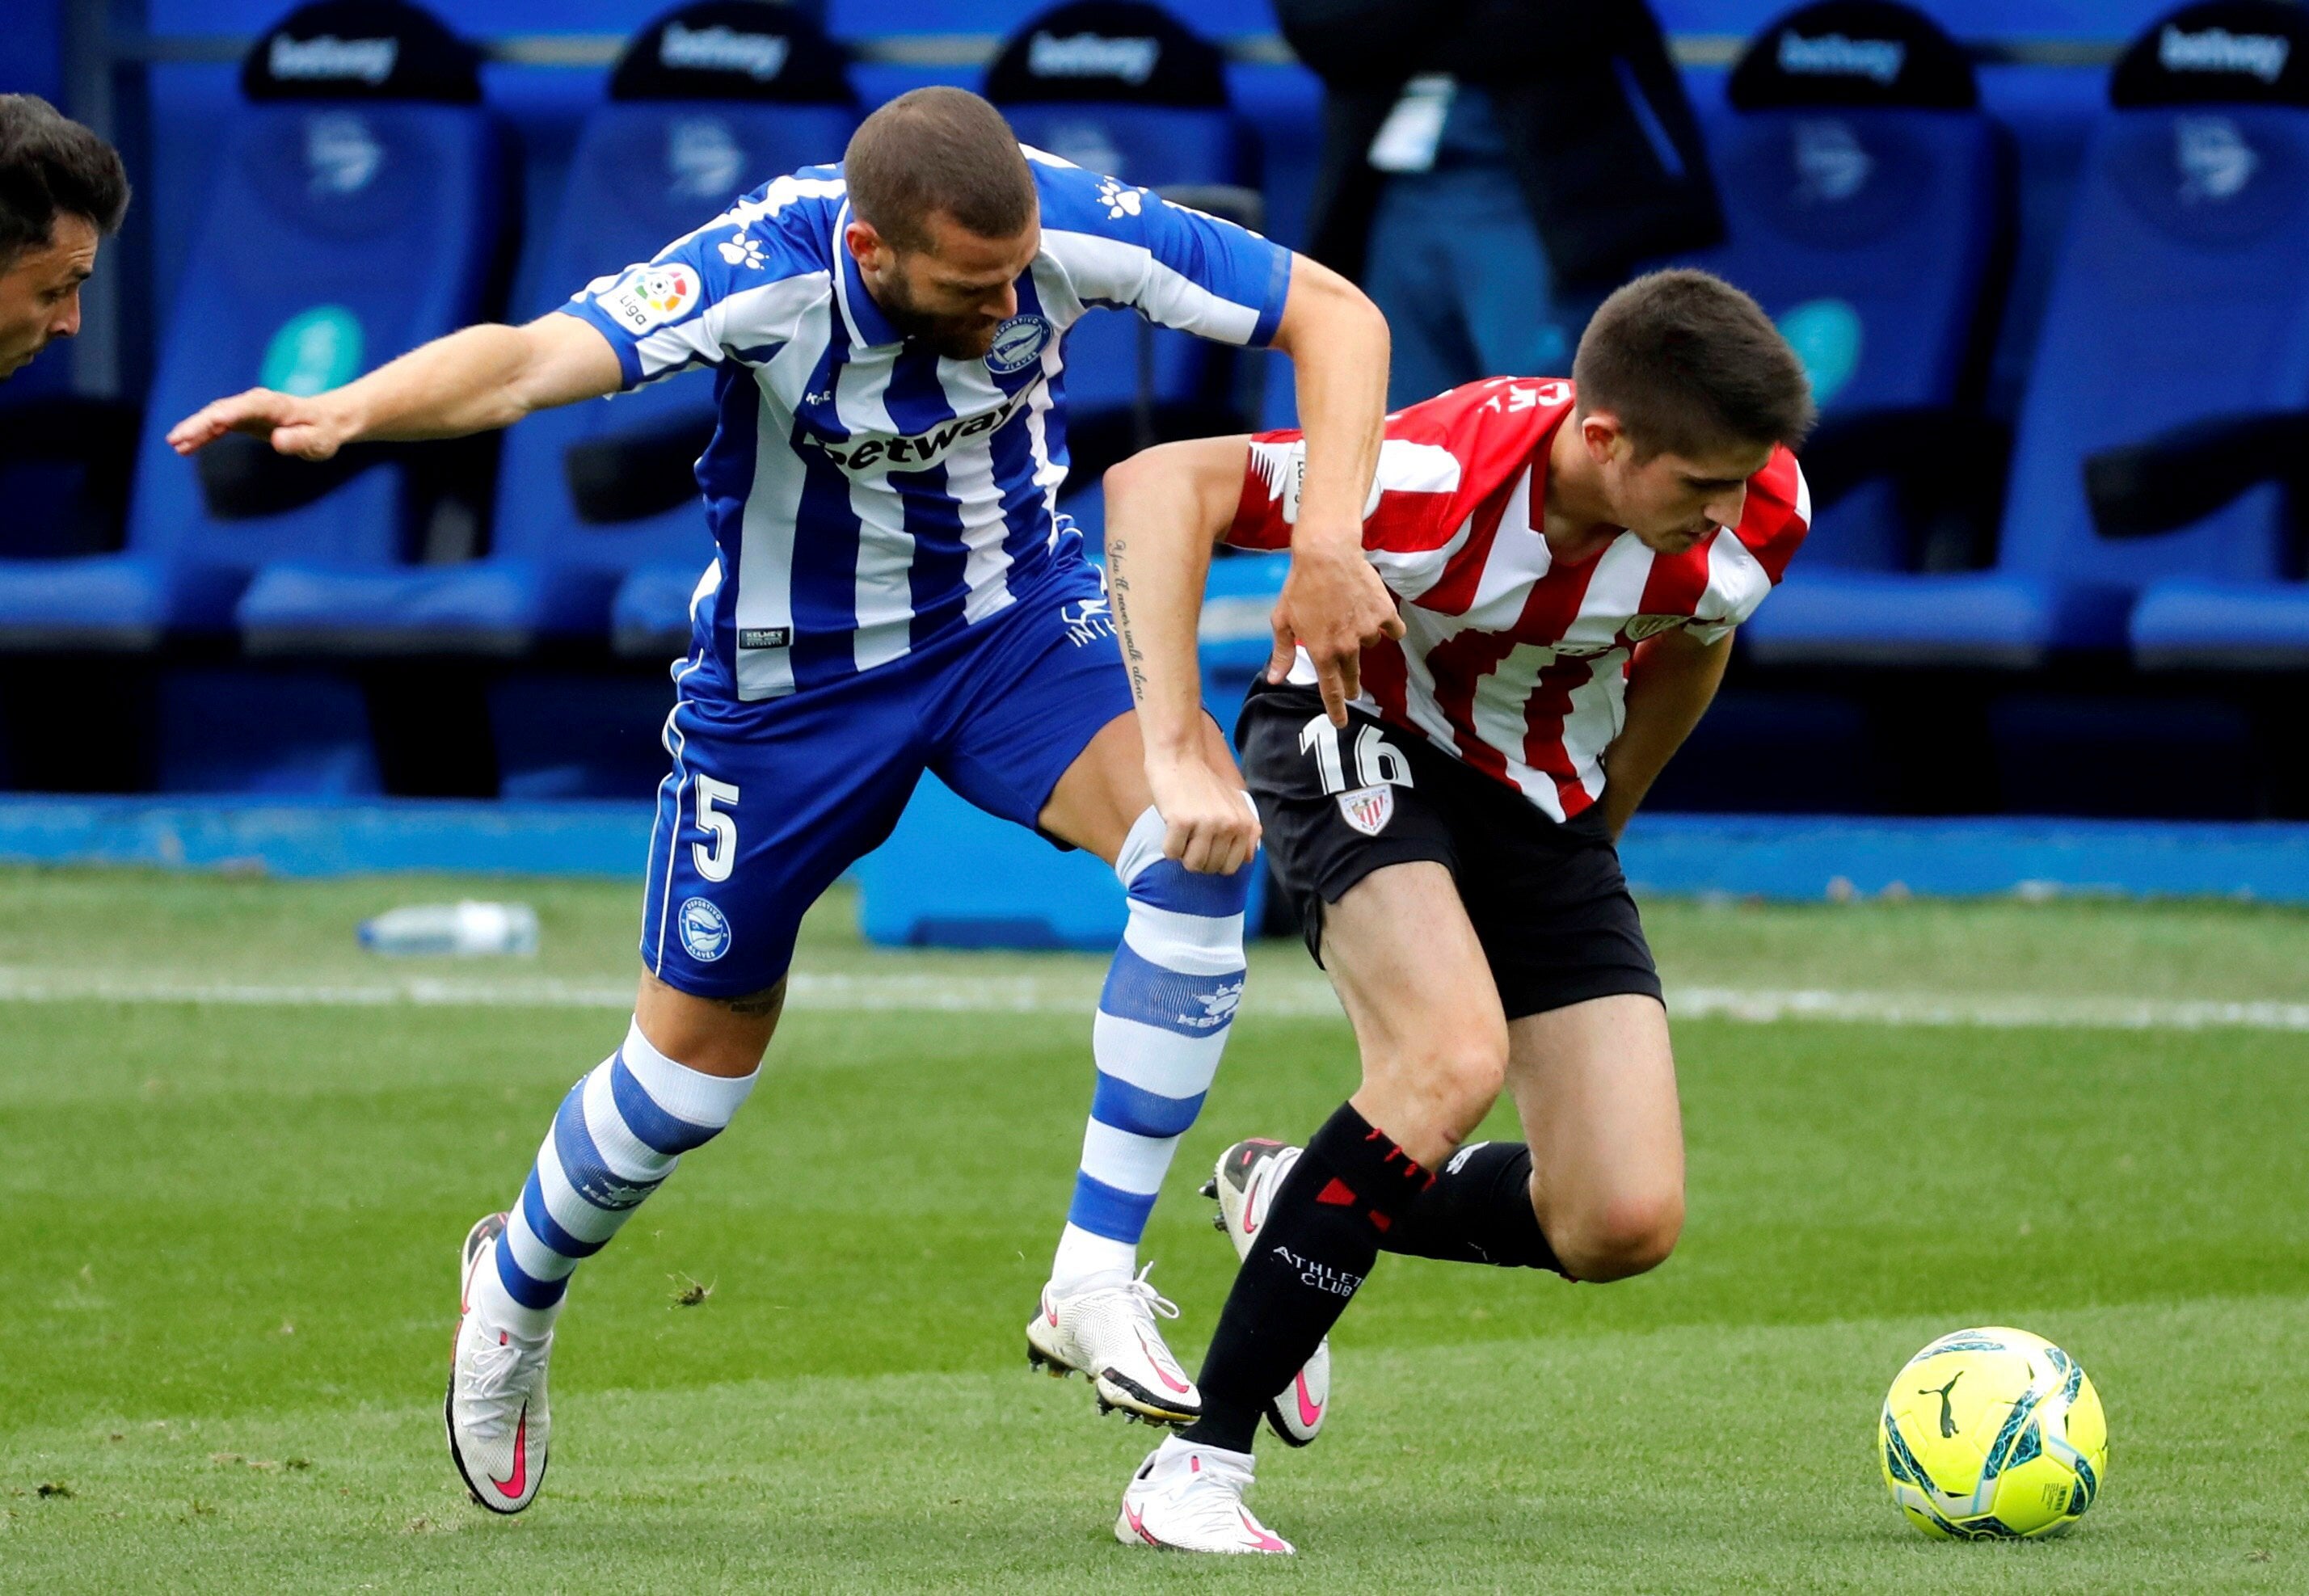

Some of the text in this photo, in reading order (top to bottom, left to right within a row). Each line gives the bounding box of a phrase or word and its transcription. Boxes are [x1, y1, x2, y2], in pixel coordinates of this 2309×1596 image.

[1117, 592, 1131, 627] never
[1124, 630, 1144, 663] walk
[1132, 665, 1148, 701] alone
[1298, 713, 1414, 796] 16
[692, 773, 739, 882] 5
[1300, 1272, 1353, 1297] CLUB
